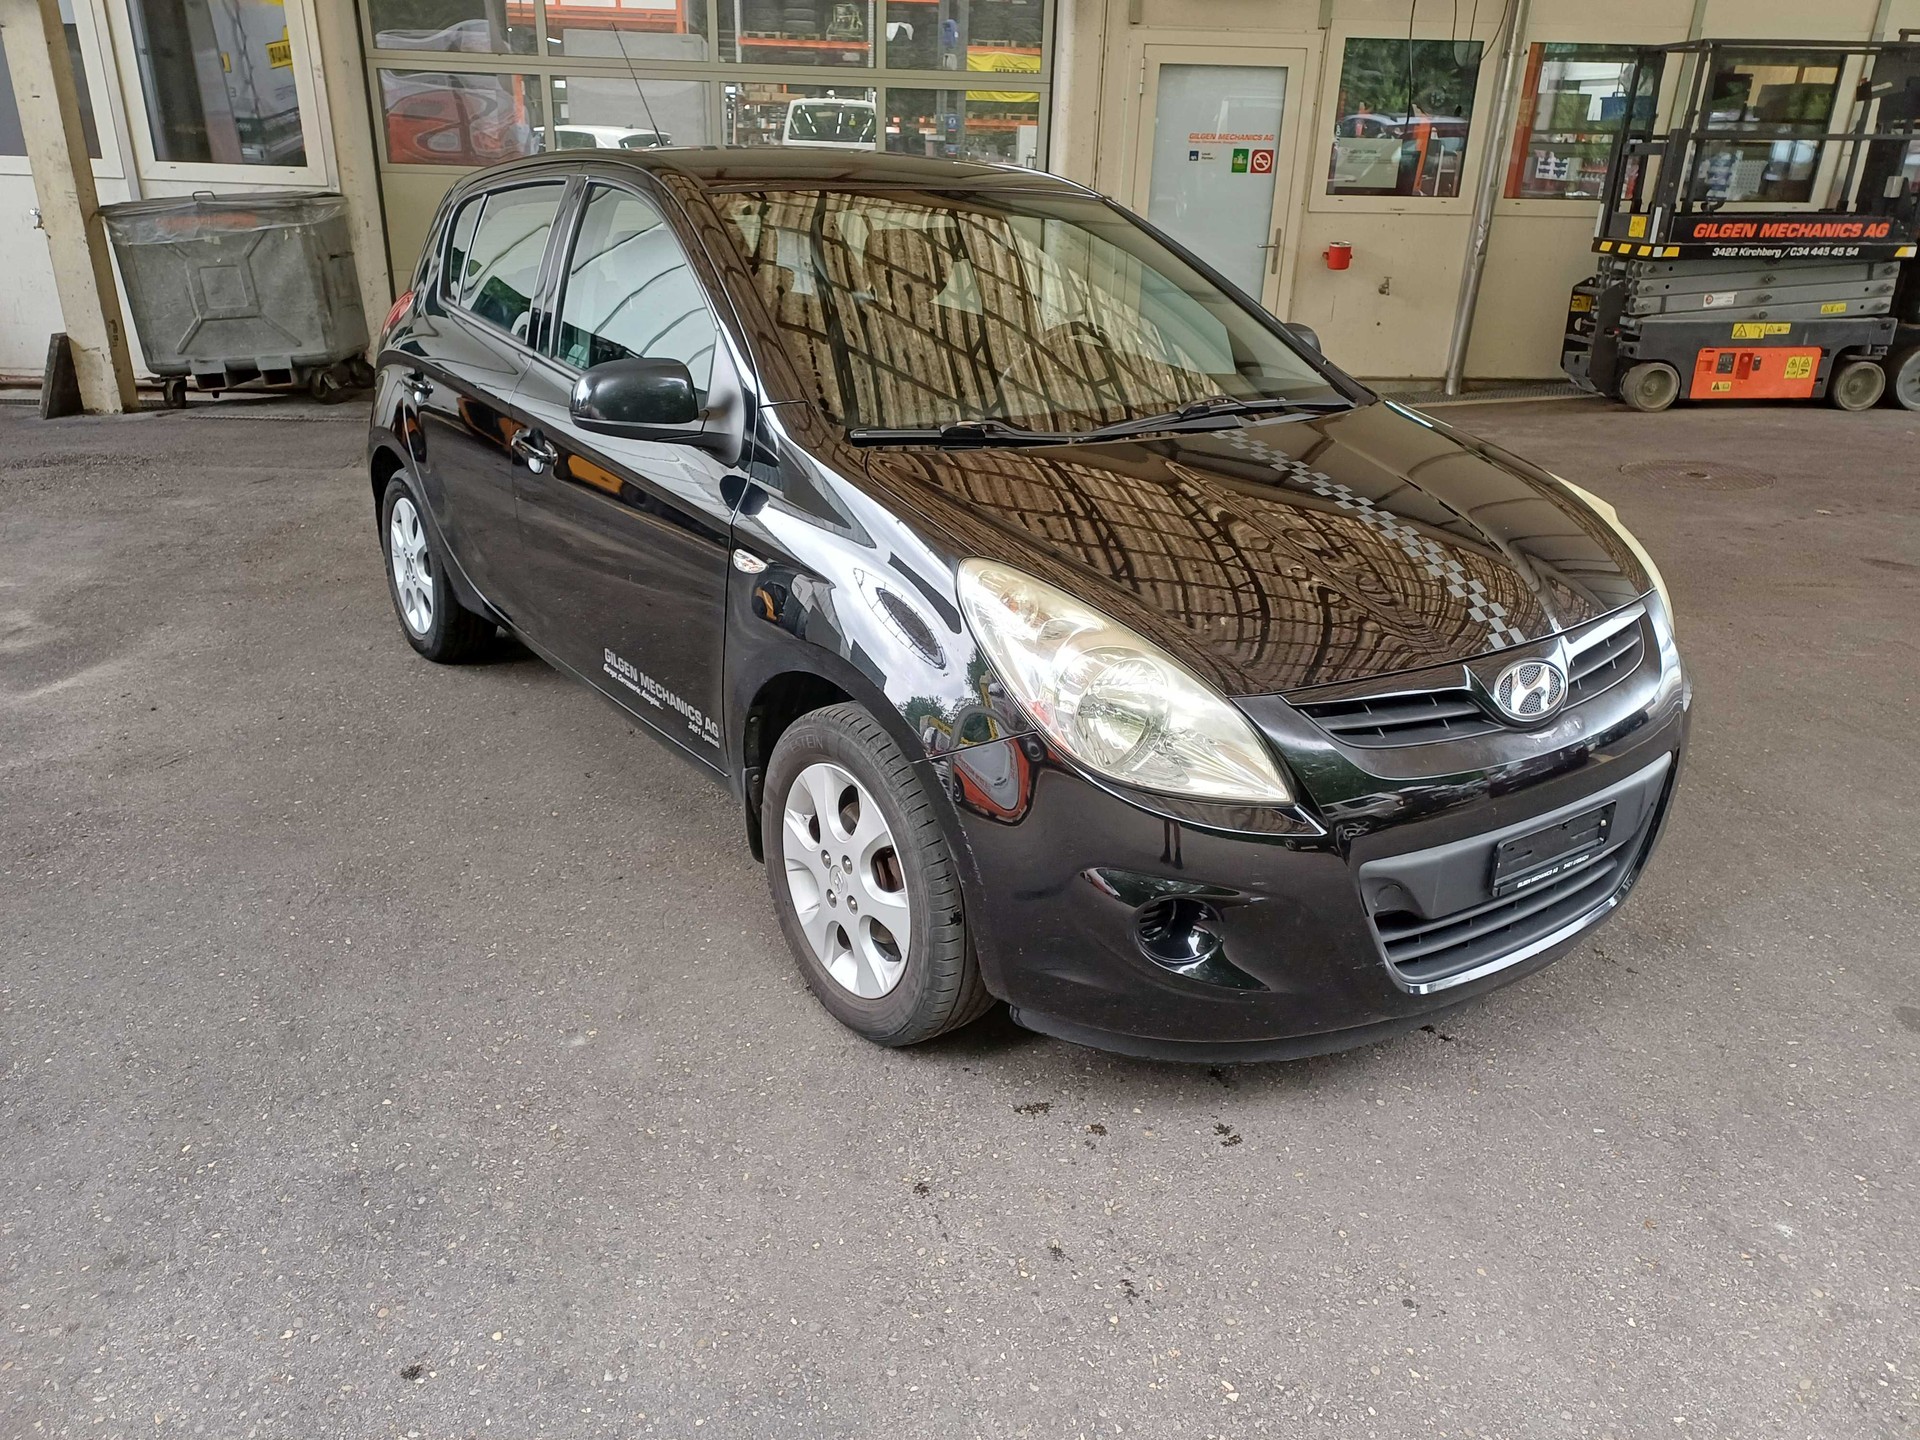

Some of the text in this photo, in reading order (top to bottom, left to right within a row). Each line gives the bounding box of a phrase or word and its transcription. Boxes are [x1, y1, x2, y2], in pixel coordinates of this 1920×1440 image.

[1218, 133, 1262, 141] MECHANICS
[1693, 223, 1890, 238] GILGEN MECHANICS AG
[1712, 247, 1738, 256] 3422
[1739, 247, 1781, 258] Kirchberg
[1810, 247, 1830, 256] 445
[1831, 247, 1845, 256] 45
[604, 648, 719, 739] GILGEN MECHANICS AG
